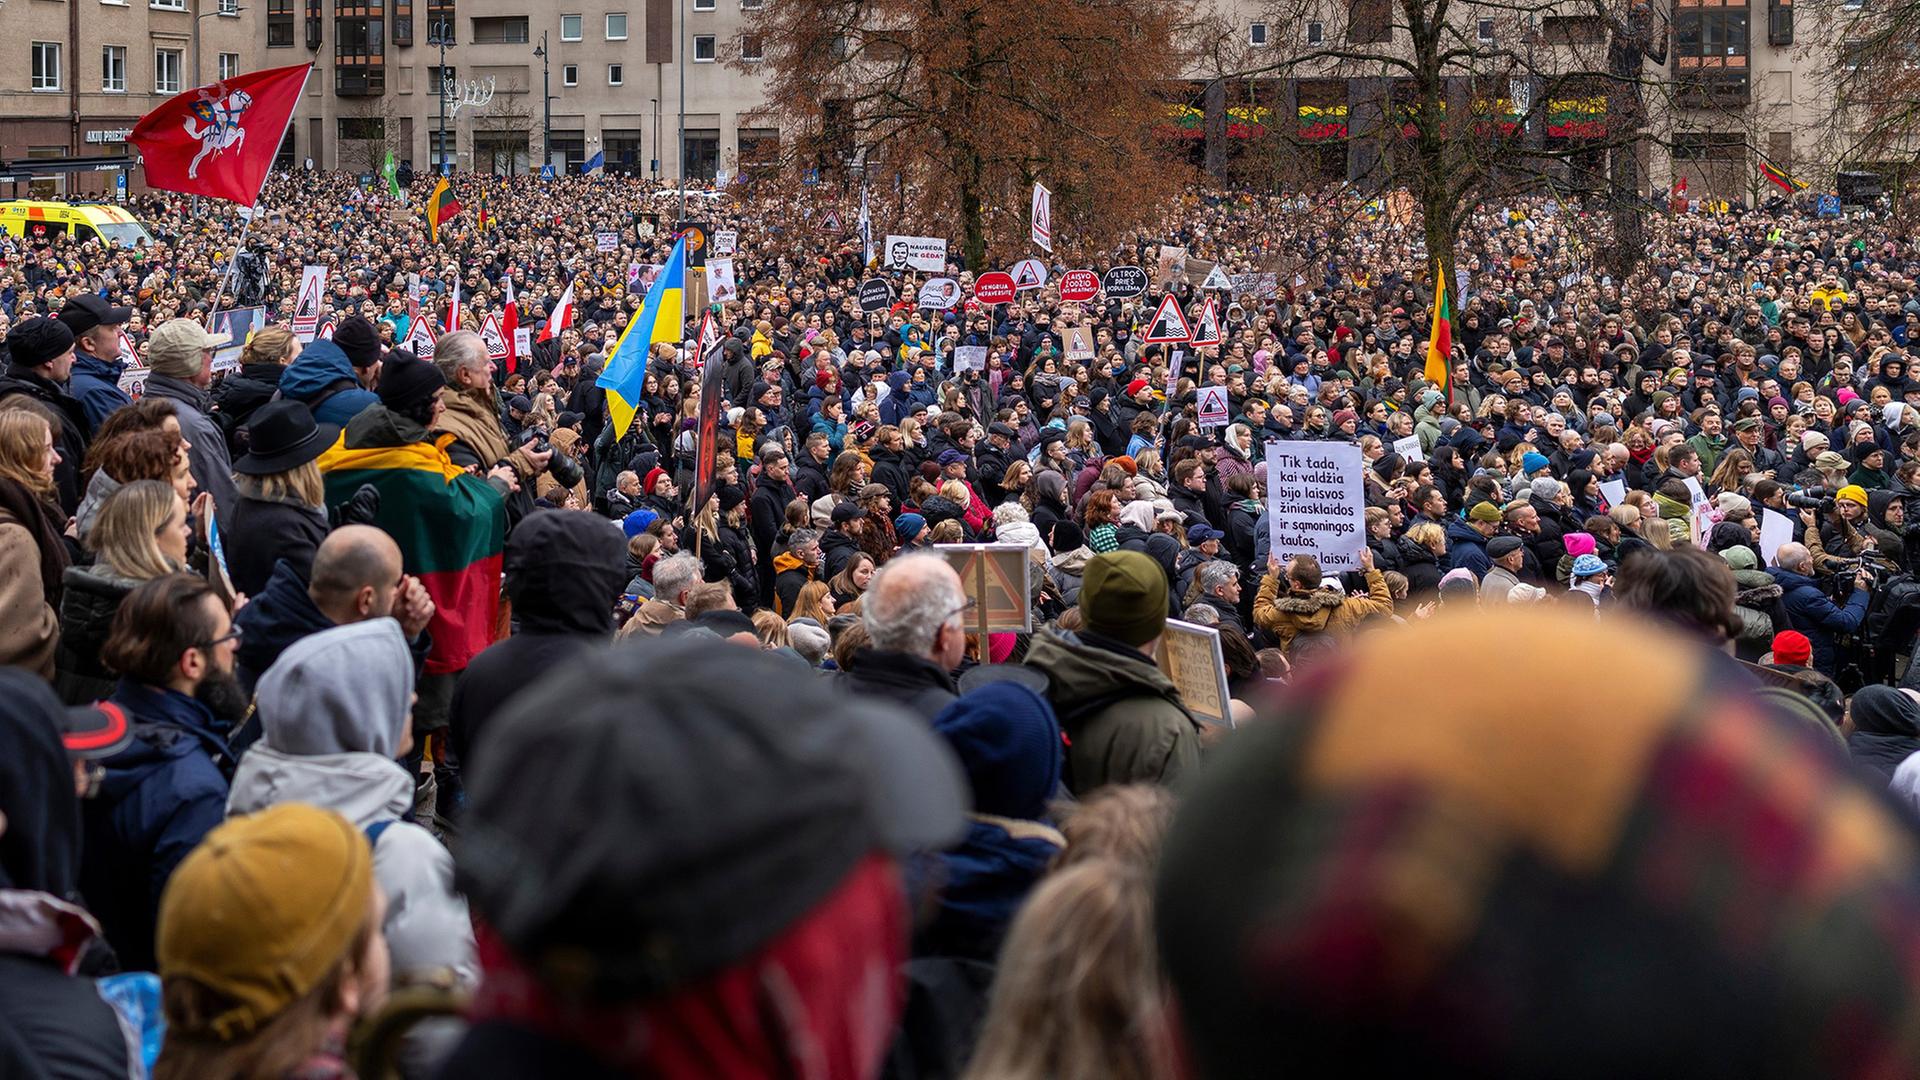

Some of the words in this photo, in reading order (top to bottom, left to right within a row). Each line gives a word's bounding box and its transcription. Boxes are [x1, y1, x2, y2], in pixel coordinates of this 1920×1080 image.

[1066, 273, 1091, 281] LAISVO
[1110, 270, 1141, 279] ULTROS
[1280, 455, 1301, 468] Tik
[1306, 456, 1339, 471] tada,
[1280, 471, 1297, 482] kai
[1301, 471, 1344, 484] valdžia
[1280, 486, 1301, 501] bijo
[1305, 487, 1344, 500] laisvos
[1280, 501, 1354, 516] žiniasklaidos
[1280, 518, 1289, 530] ir
[1292, 520, 1355, 537] sąmoningos
[1280, 534, 1319, 548] tautos,
[1320, 552, 1353, 565] laisvi.
